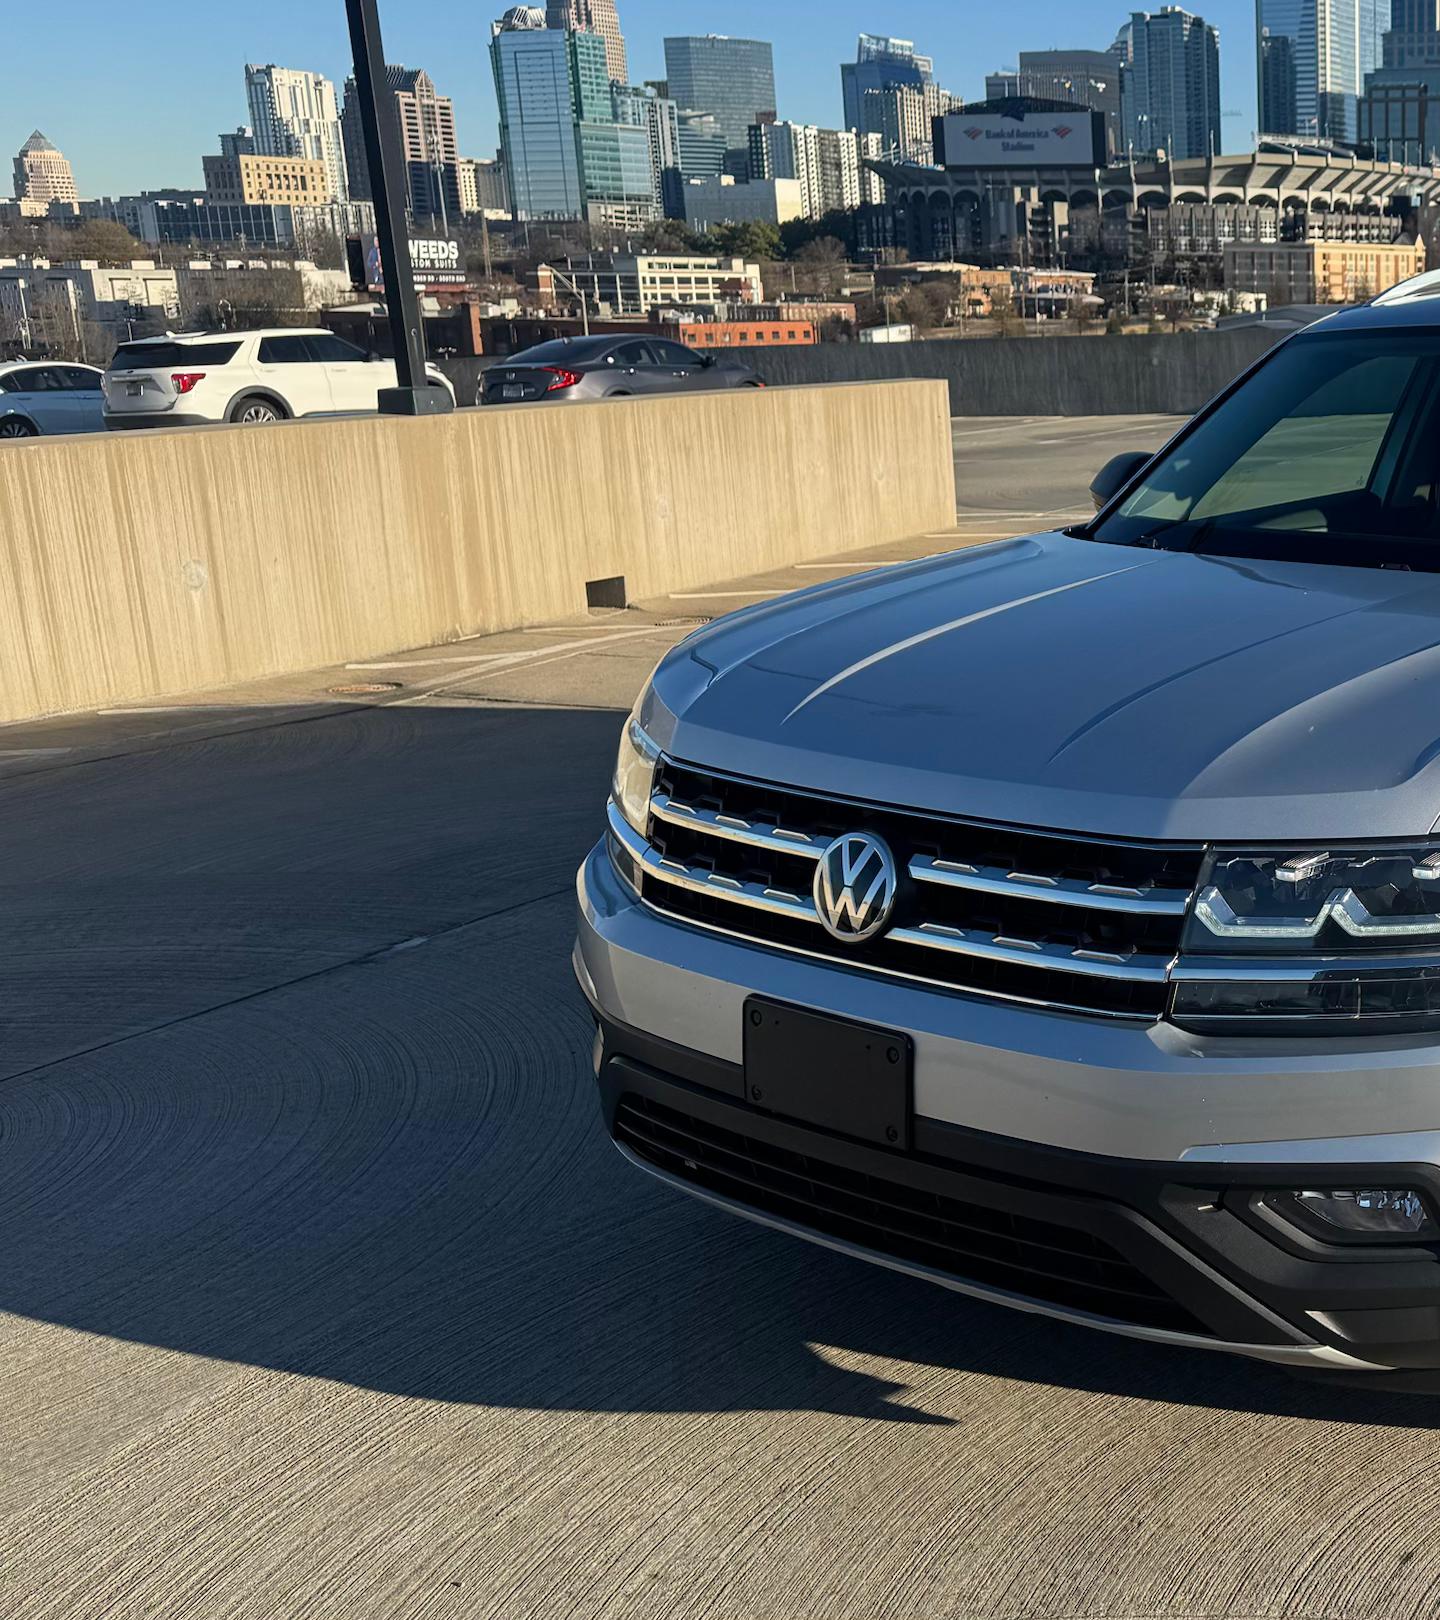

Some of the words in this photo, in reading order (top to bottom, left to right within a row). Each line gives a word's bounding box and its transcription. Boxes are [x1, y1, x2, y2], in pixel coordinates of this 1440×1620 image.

[985, 128, 1004, 139] Bank
[1015, 128, 1049, 139] America
[1001, 141, 1035, 151] Stadium
[434, 259, 457, 269] SUITS
